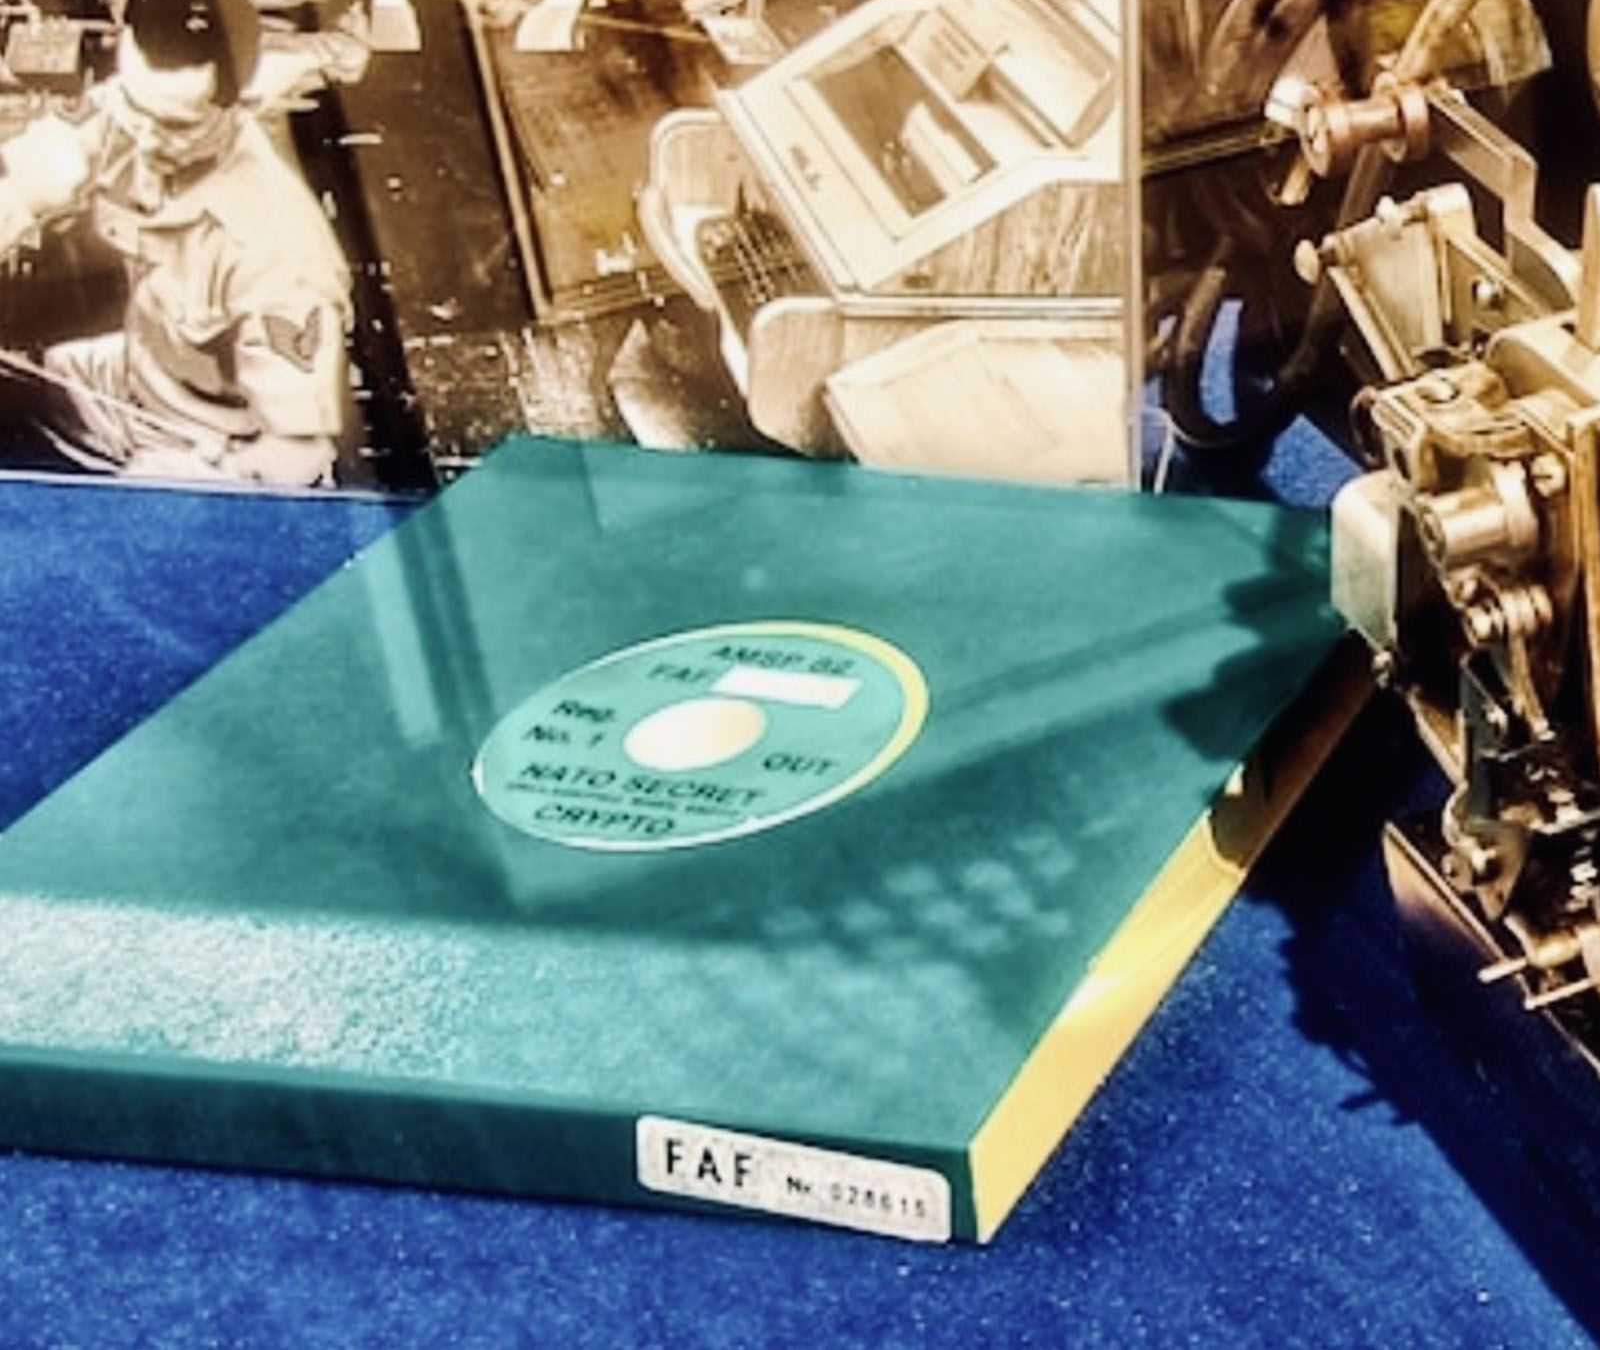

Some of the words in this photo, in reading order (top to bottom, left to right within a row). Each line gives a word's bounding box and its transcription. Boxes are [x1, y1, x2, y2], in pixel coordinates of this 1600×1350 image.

[520, 762, 617, 788] NATO
[621, 774, 766, 805] SECRET
[762, 753, 838, 777] OUT
[532, 804, 677, 835] CRYPTO
[665, 1138, 754, 1189] FAF
